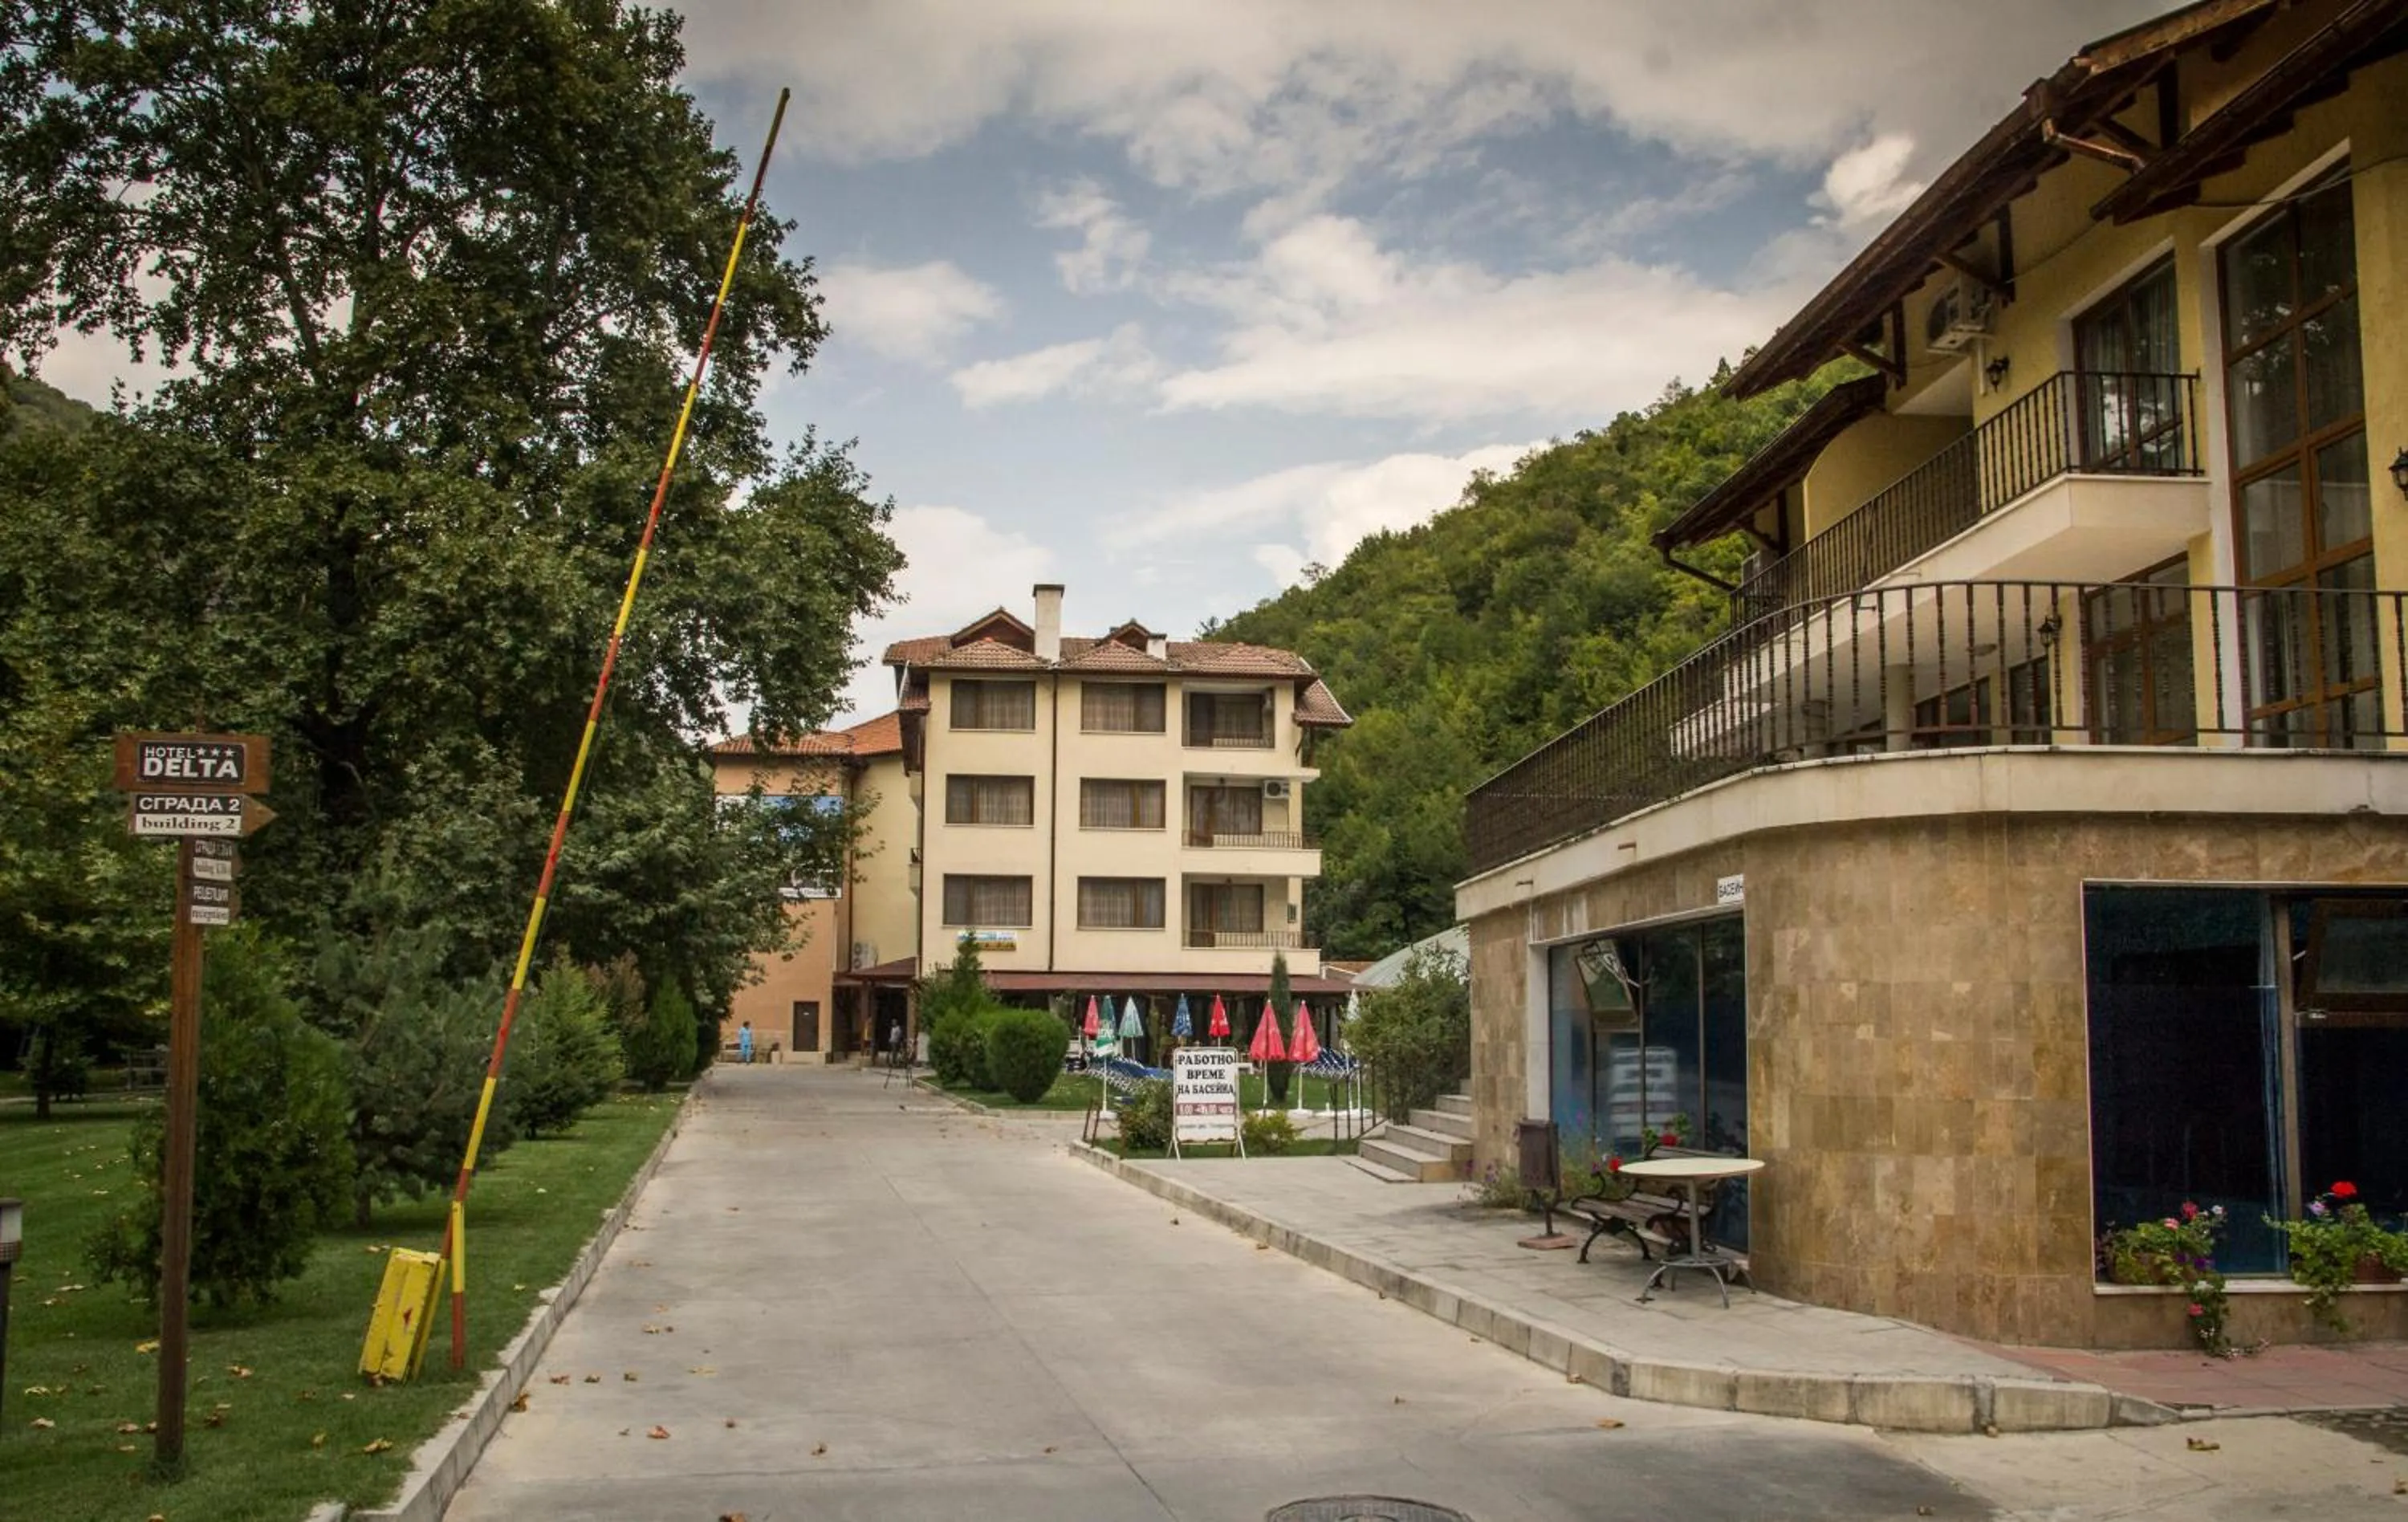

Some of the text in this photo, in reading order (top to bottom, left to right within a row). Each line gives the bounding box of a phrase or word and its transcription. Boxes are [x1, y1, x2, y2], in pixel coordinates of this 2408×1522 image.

[145, 746, 196, 759] HOTEL
[143, 758, 238, 778] DELTA
[139, 797, 240, 812] СГРАДА 2
[142, 816, 235, 831] building 2
[1178, 1054, 1234, 1065] РАБОТНО
[1187, 1068, 1226, 1080] ВРЕМЕ
[1178, 1083, 1234, 1094] НА БАСЕЙНА
